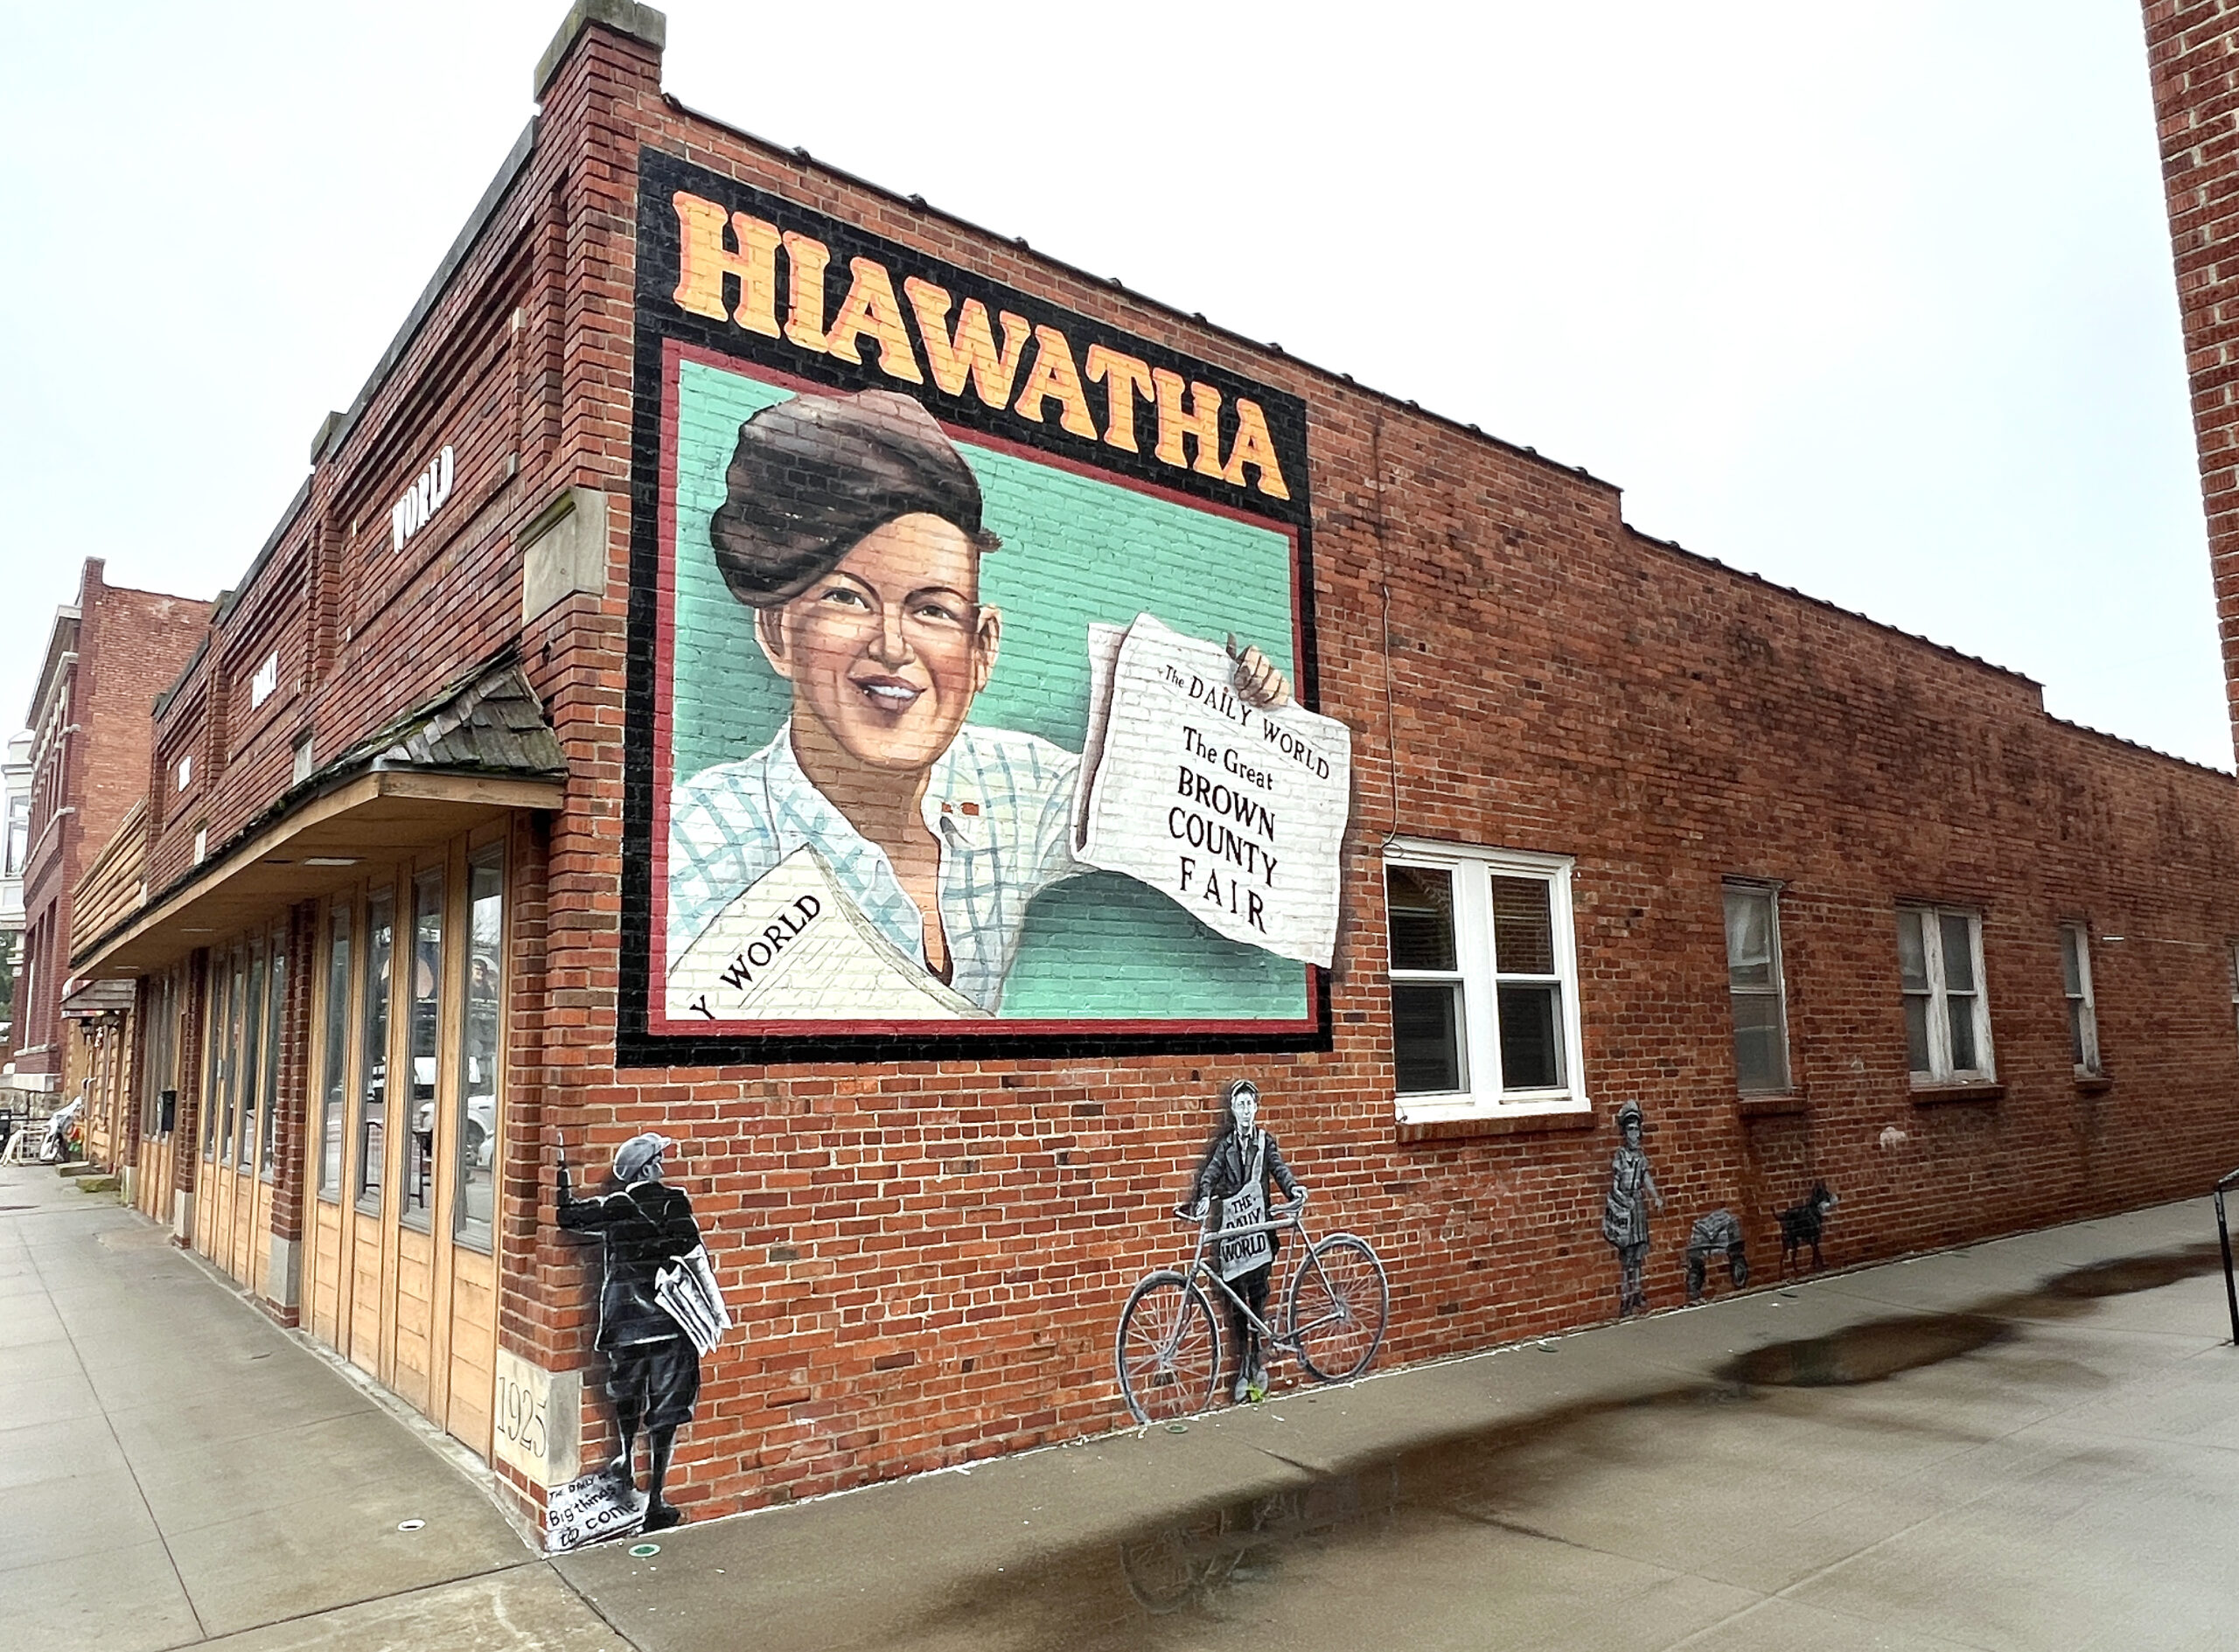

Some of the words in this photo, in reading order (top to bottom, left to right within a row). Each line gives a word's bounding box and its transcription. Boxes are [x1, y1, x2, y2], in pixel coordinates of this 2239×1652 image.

[672, 190, 1291, 501] HIAWATHA
[1166, 665, 1184, 688] The
[1189, 676, 1252, 727] DAILY
[1263, 719, 1329, 780] WORLD
[1183, 726, 1217, 763] The
[1224, 749, 1273, 791] Great
[1177, 766, 1275, 842] BROWN
[1168, 807, 1278, 888] COUNTY
[1180, 856, 1266, 934] FAIR
[720, 895, 821, 991] WORLD
[1231, 1194, 1252, 1214] THE
[1222, 1235, 1266, 1263] WORLD
[497, 1377, 547, 1458] 1925
[549, 1509, 574, 1527] Big
[574, 1485, 617, 1512] things
[585, 1502, 640, 1530] come
